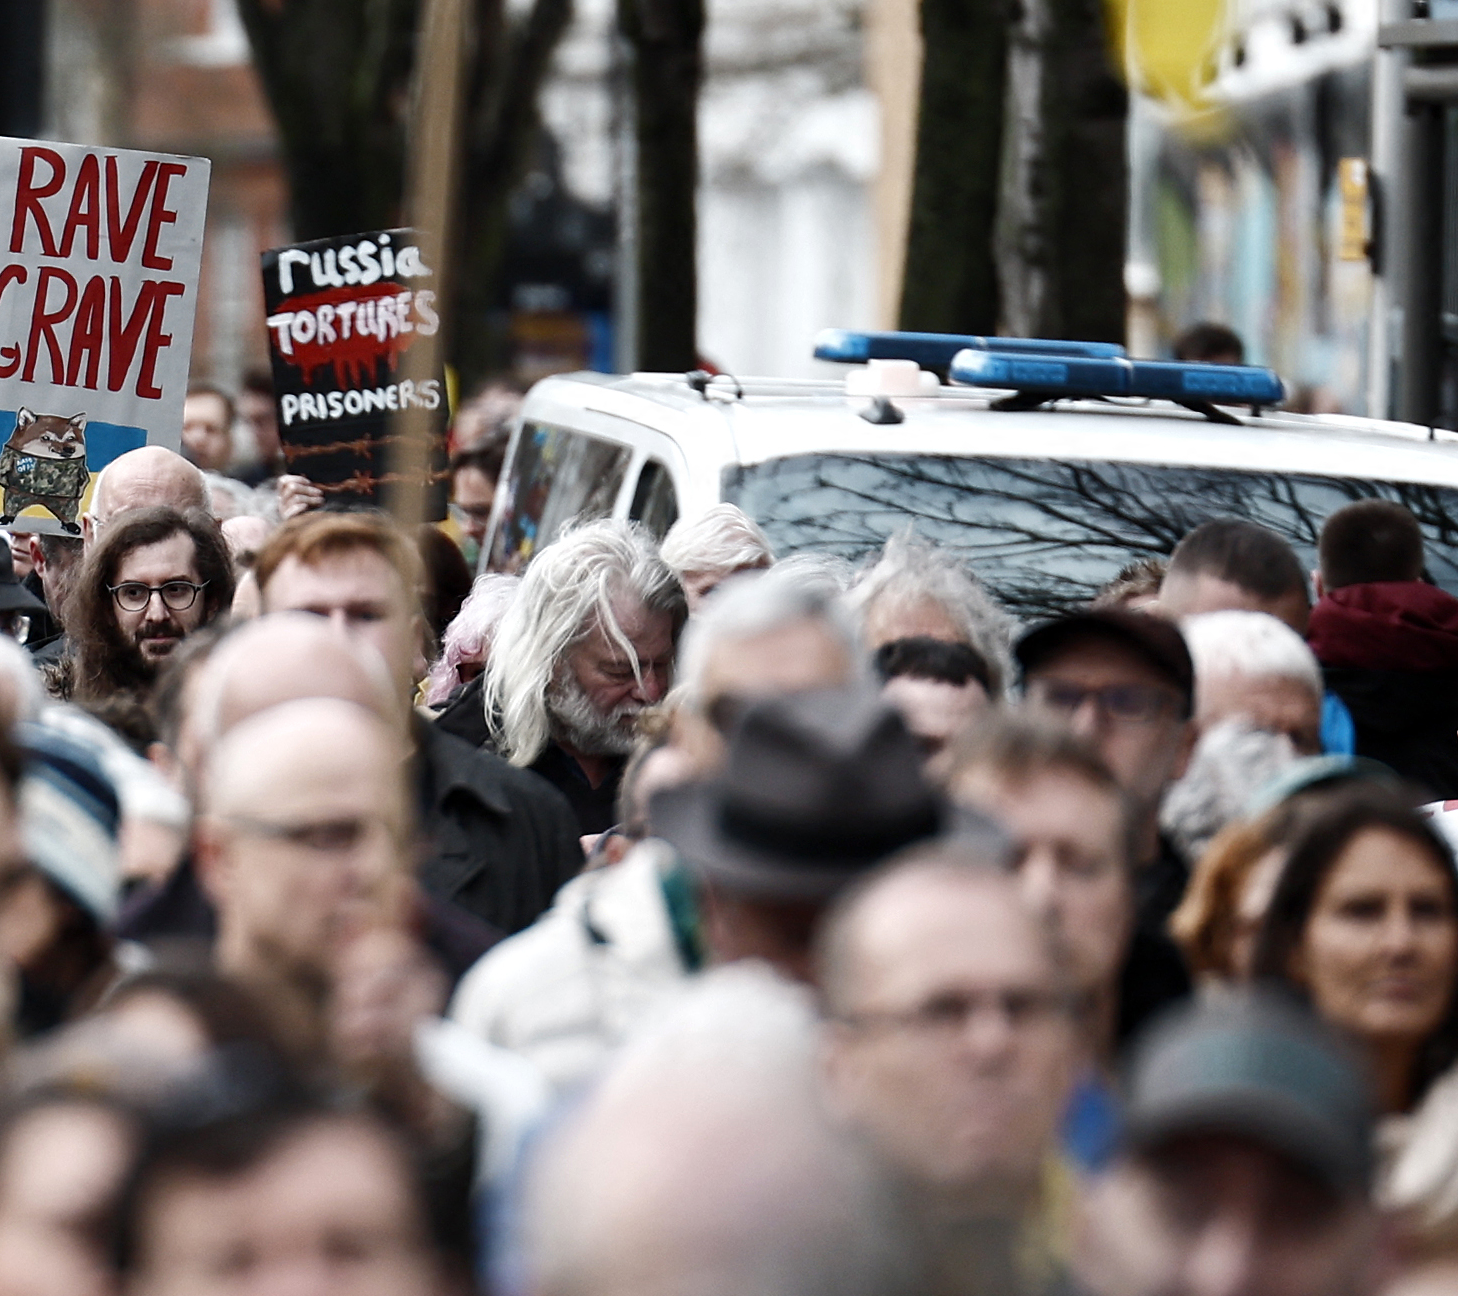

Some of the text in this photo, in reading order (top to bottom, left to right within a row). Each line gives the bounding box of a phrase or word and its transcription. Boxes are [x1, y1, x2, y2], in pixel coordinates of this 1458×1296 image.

[8, 146, 188, 271] RAVE
[266, 289, 440, 355] TORTURES
[281, 378, 441, 426] PRISONERS
